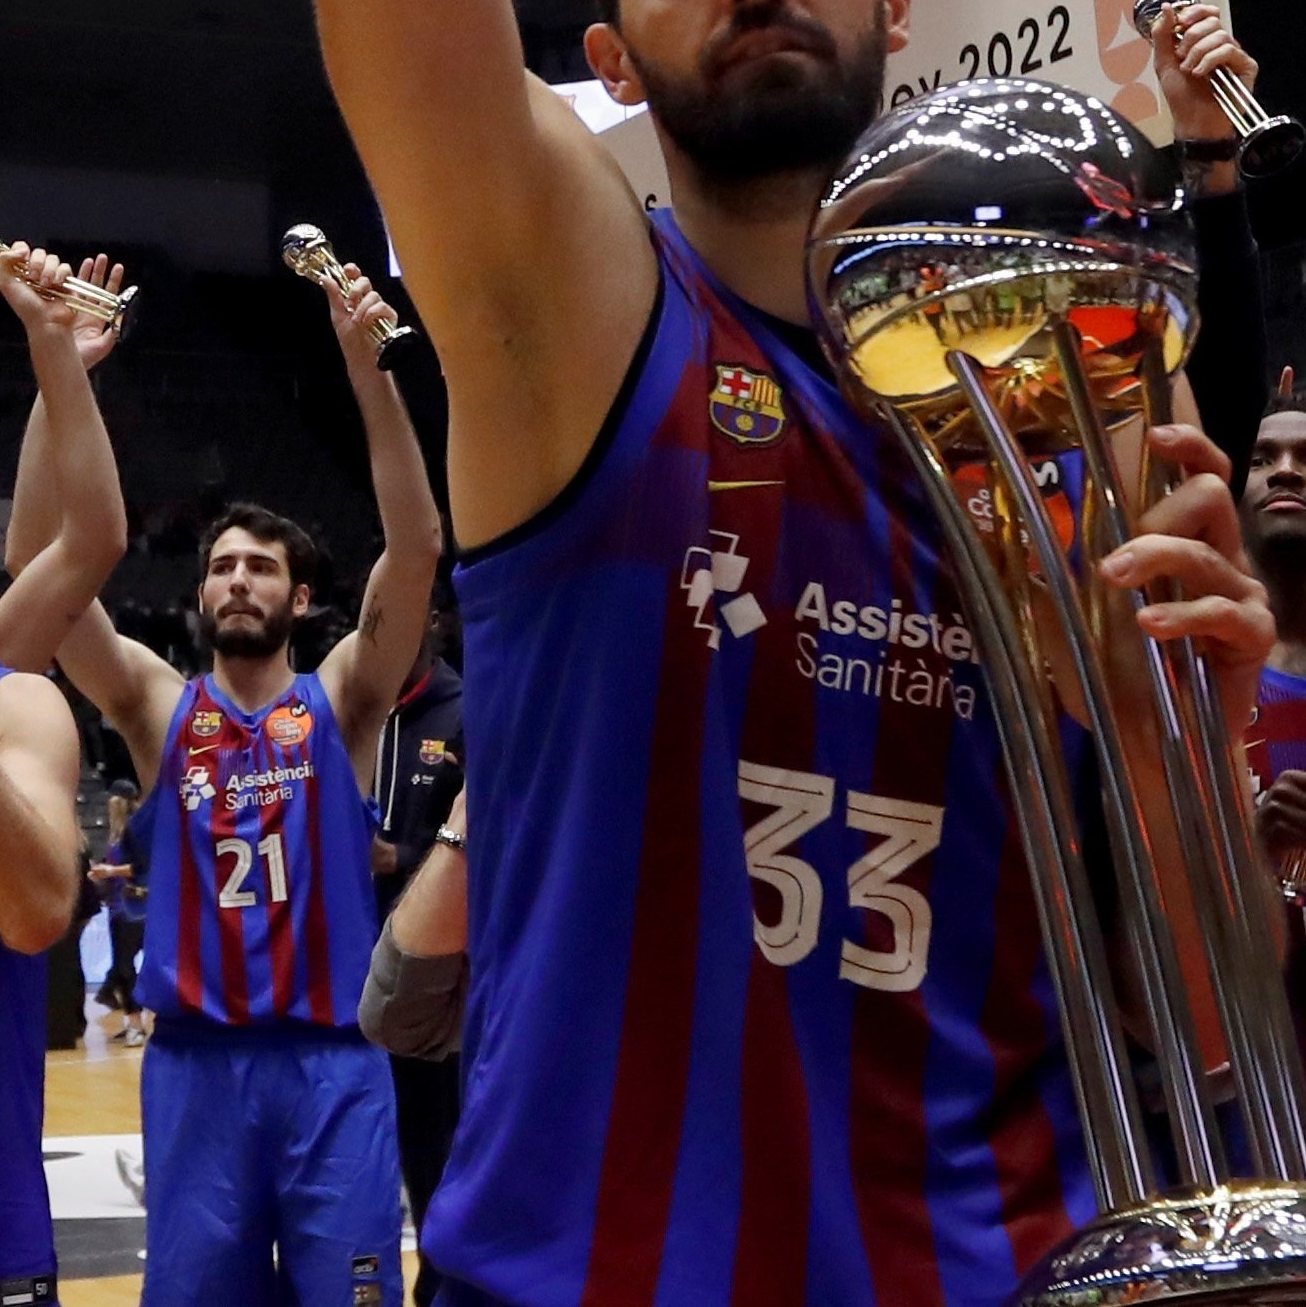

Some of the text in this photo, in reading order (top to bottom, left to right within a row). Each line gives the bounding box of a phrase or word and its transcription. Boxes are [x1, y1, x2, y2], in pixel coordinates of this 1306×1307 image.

[959, 6, 1073, 79] 2022
[795, 581, 980, 665] Assistè
[216, 833, 288, 908] 21
[737, 758, 946, 993] 33
